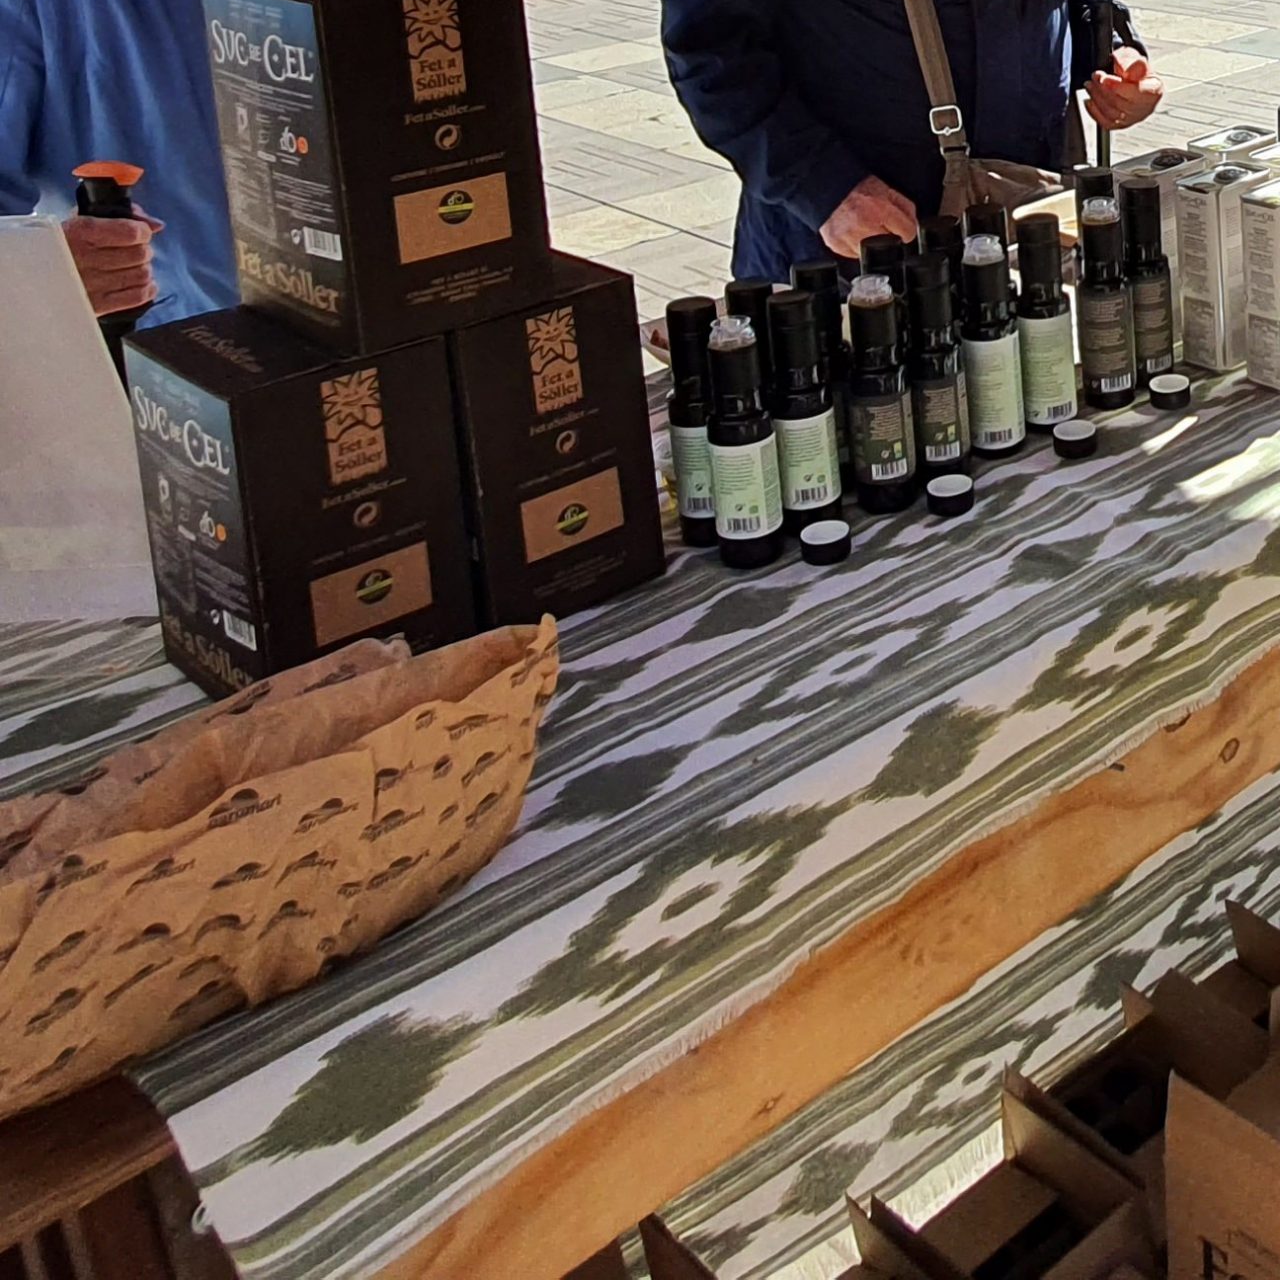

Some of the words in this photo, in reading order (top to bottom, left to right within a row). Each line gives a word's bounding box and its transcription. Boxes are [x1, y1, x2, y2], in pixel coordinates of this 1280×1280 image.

[211, 19, 248, 66] SUC
[263, 34, 315, 83] CEL
[134, 385, 170, 441] SUC
[183, 419, 230, 476] CEL
